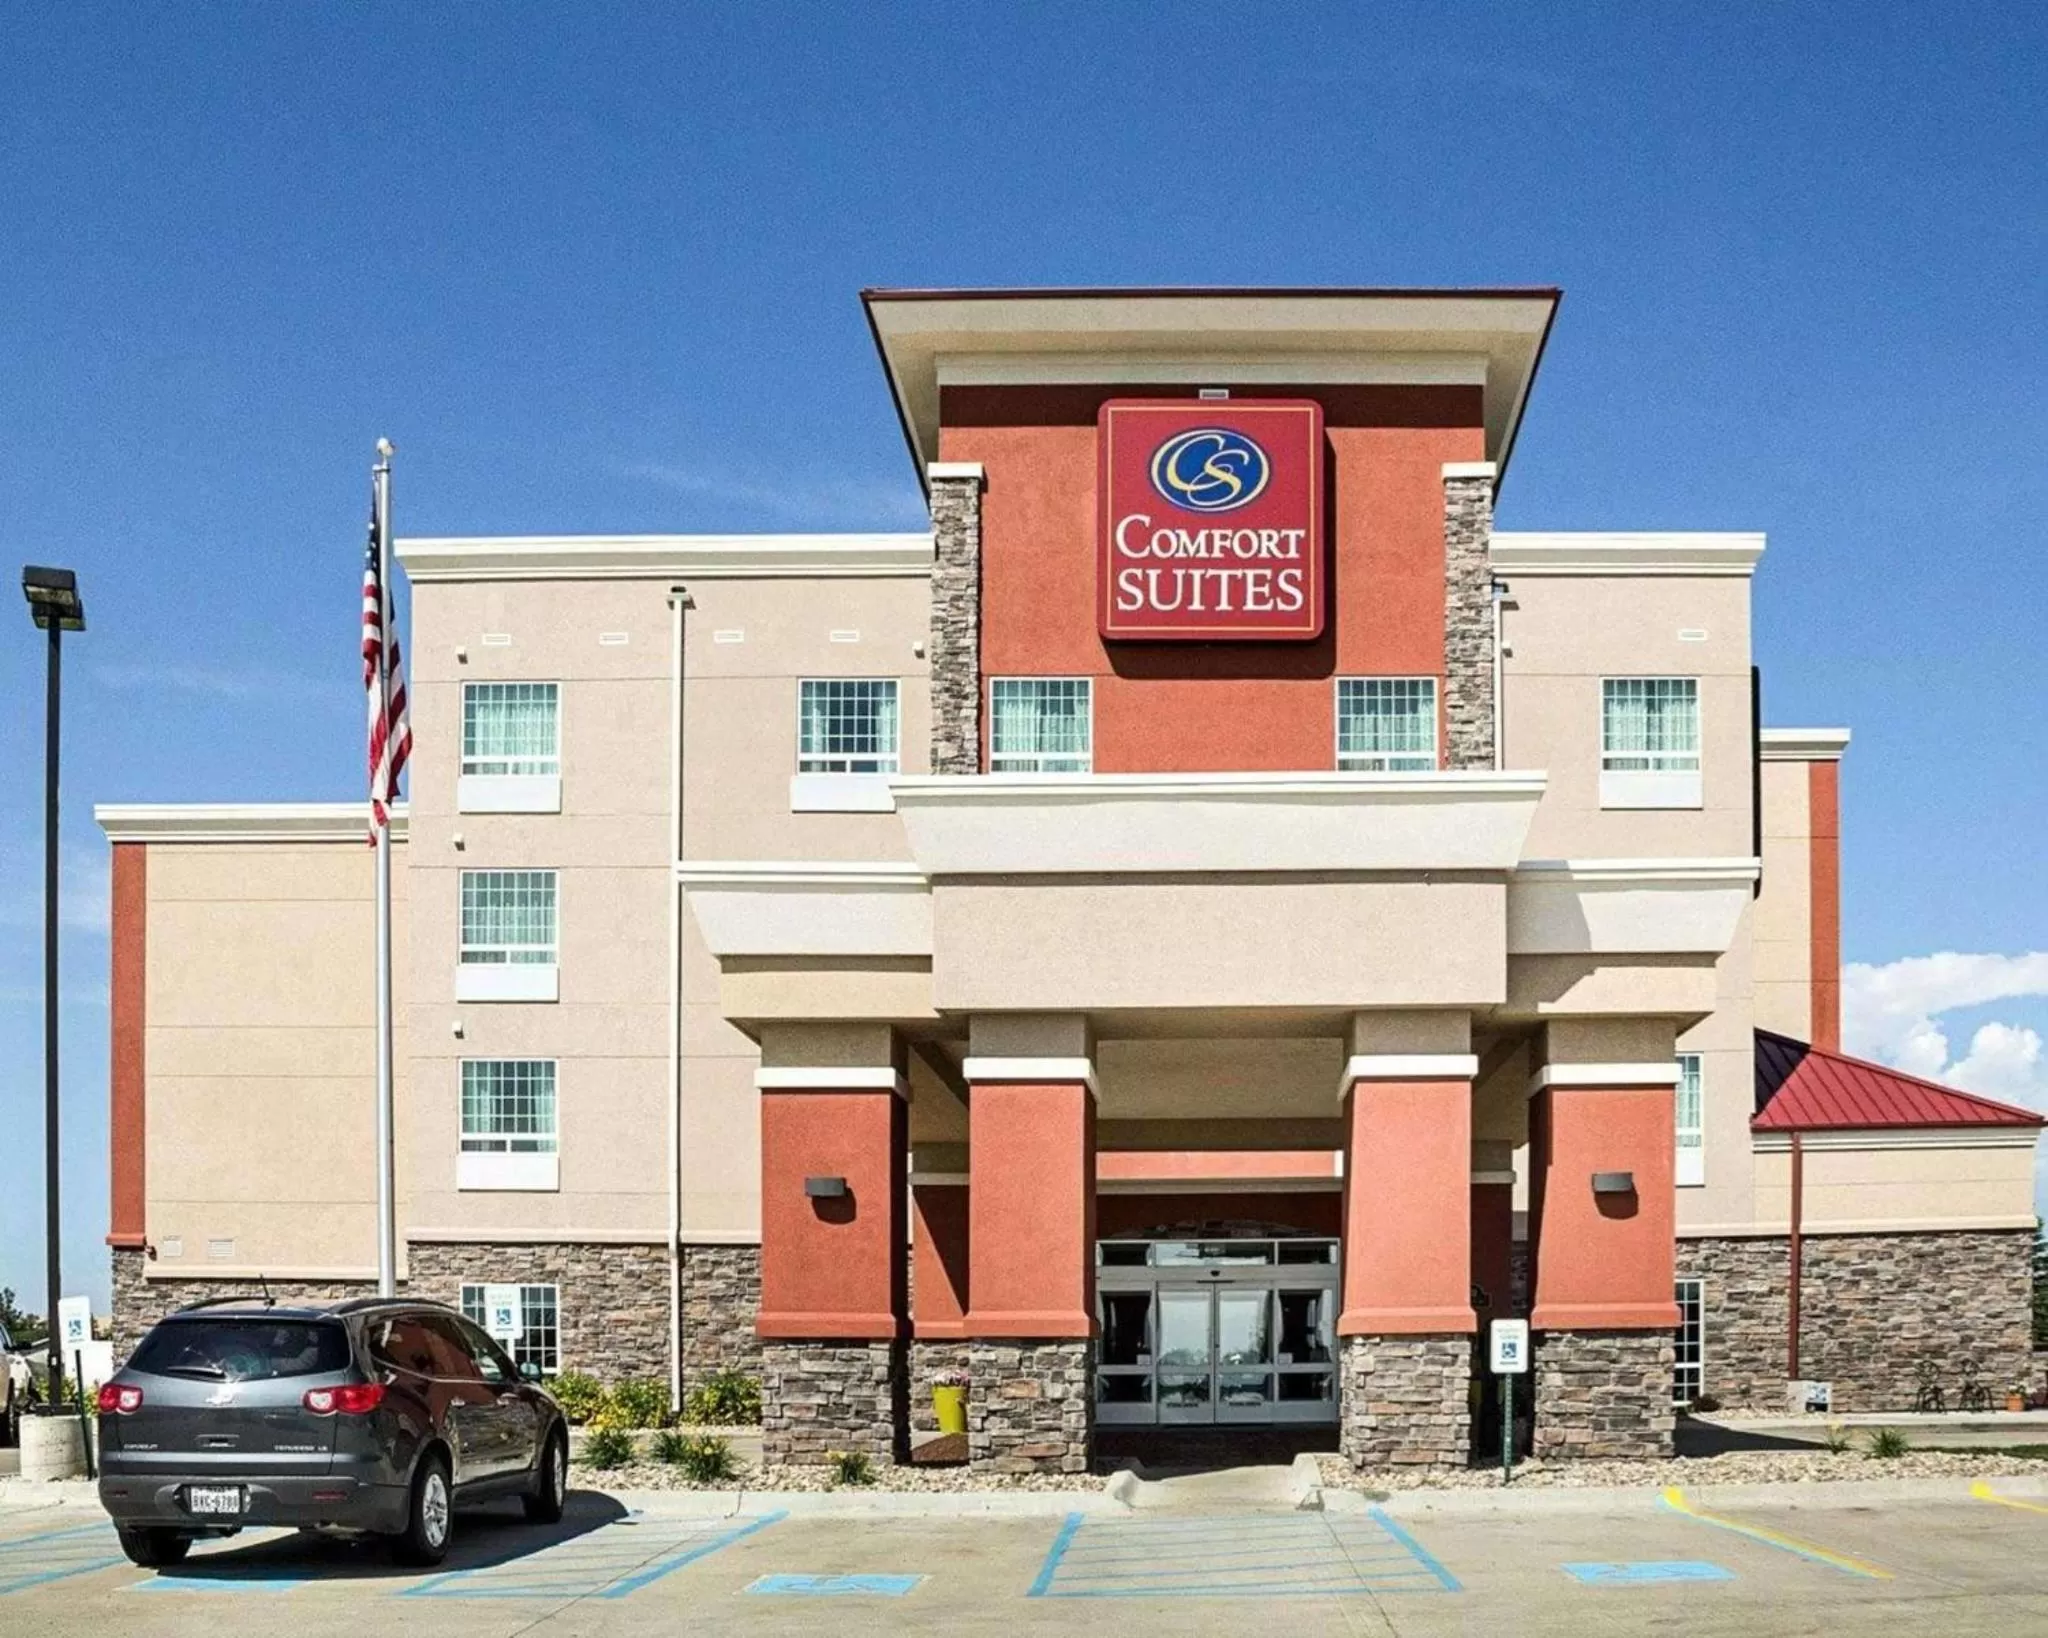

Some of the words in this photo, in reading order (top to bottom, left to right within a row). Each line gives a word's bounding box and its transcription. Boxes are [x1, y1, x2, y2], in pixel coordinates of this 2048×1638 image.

[1166, 433, 1250, 507] CS
[1115, 513, 1306, 559] COMFORT
[1116, 567, 1304, 612] SUITES
